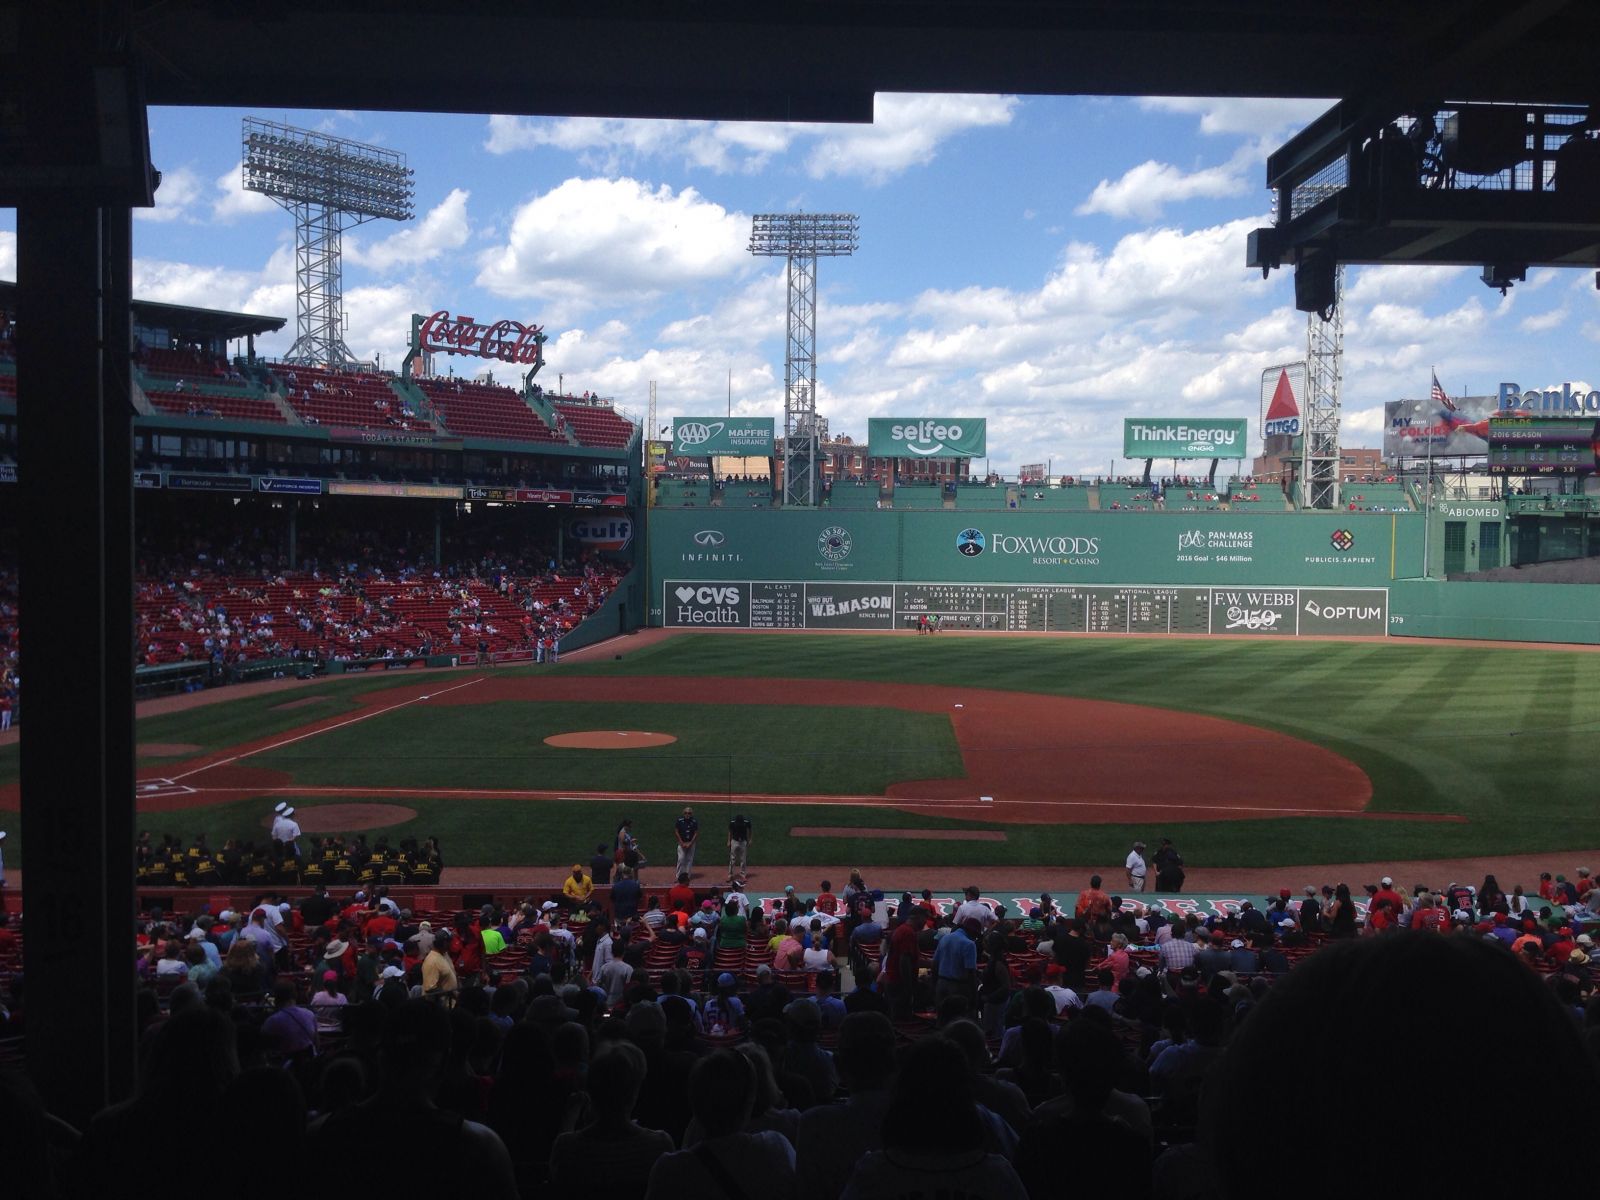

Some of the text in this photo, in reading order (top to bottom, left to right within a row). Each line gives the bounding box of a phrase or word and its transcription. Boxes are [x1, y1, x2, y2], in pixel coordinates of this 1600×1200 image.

[420, 310, 544, 364] Coca-Cola
[1500, 382, 1581, 412] Bank
[1265, 418, 1298, 436] CITGO
[1392, 418, 1412, 428] MY
[1448, 508, 1500, 517] ABIOMED
[574, 520, 629, 538] Gulf
[832, 528, 846, 537] SOX
[1208, 532, 1252, 540] PAN-MASS
[992, 534, 1098, 554] FOXWOODS
[682, 554, 740, 562] INFINITI
[696, 586, 740, 604] CVS
[1214, 592, 1294, 606] F.W. WEBB
[677, 606, 740, 622] Health
[1324, 607, 1380, 620] OPTUM
